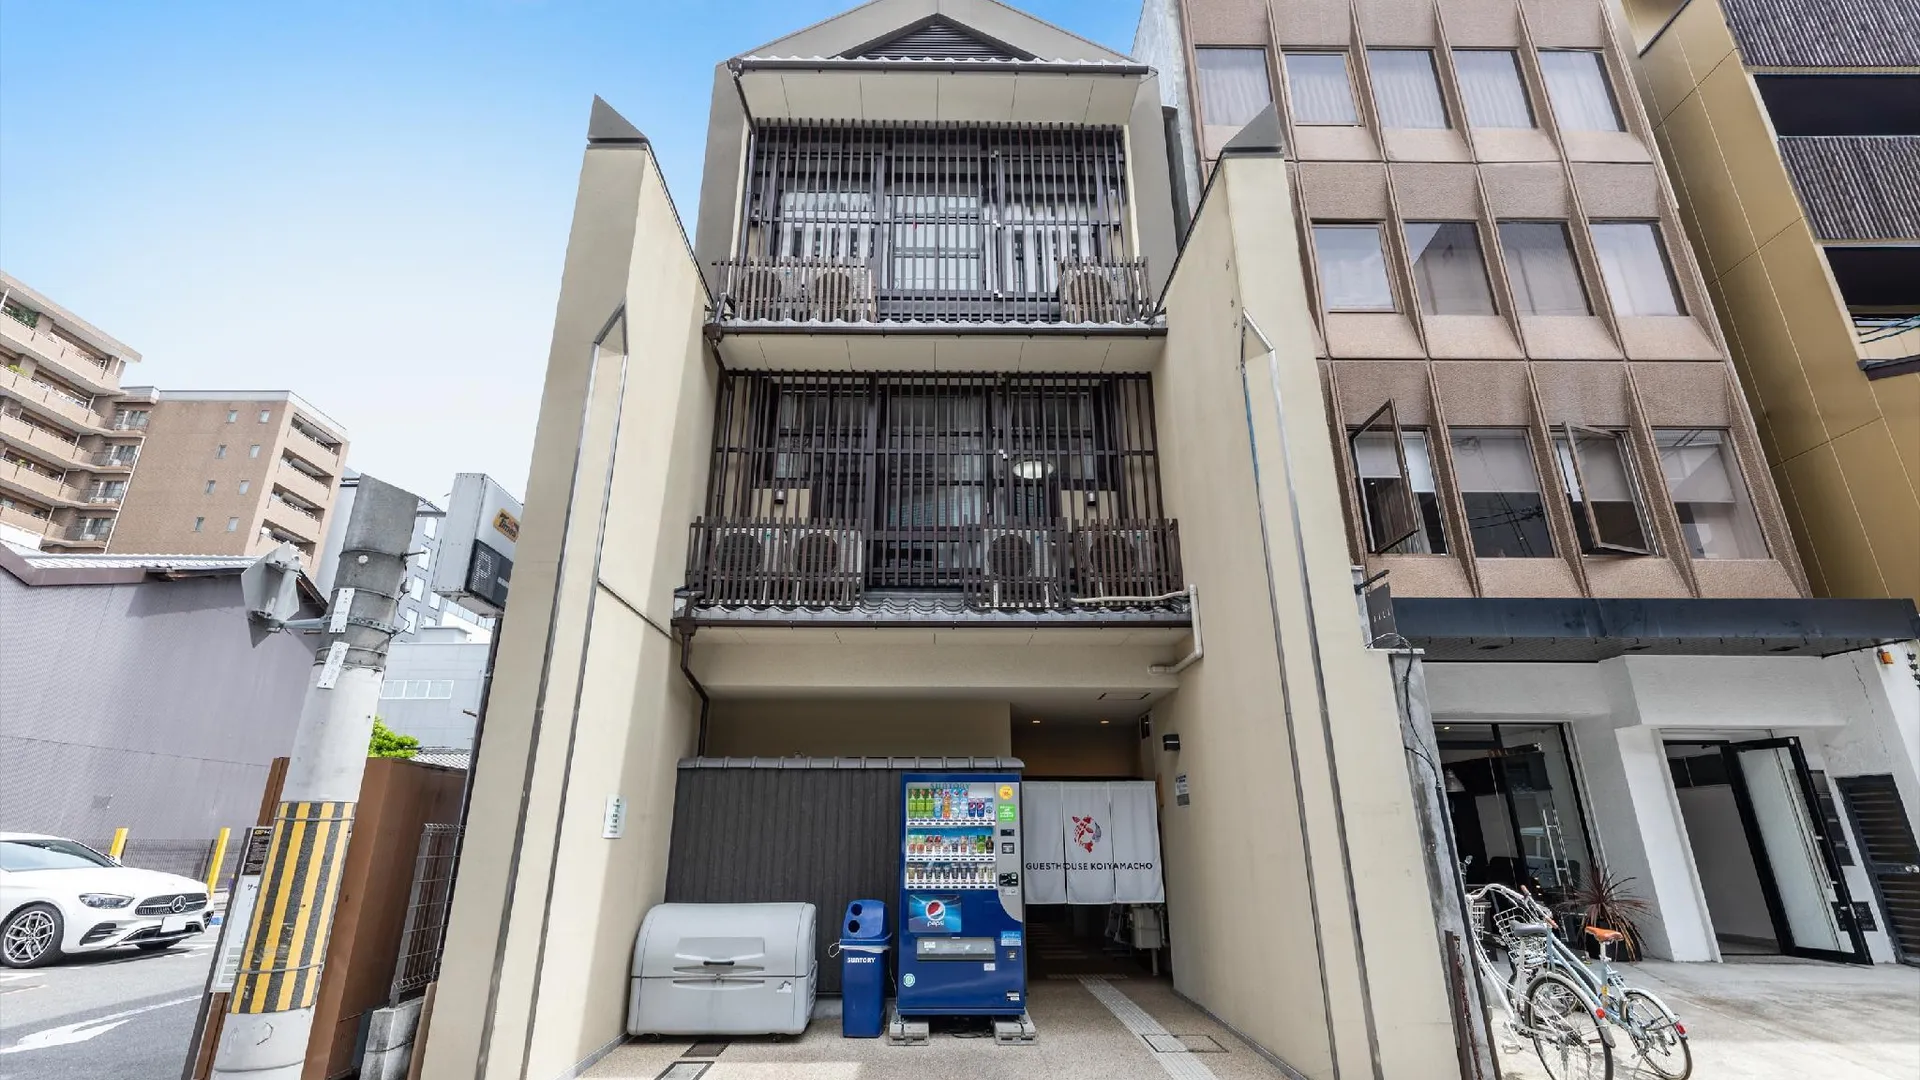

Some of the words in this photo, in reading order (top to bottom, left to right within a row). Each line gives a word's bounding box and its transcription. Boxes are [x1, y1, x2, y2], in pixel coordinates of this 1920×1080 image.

[1026, 862, 1088, 871] GUESTHOUSE
[1091, 862, 1153, 871] KOIYAMACHO
[927, 920, 944, 928] pepsi
